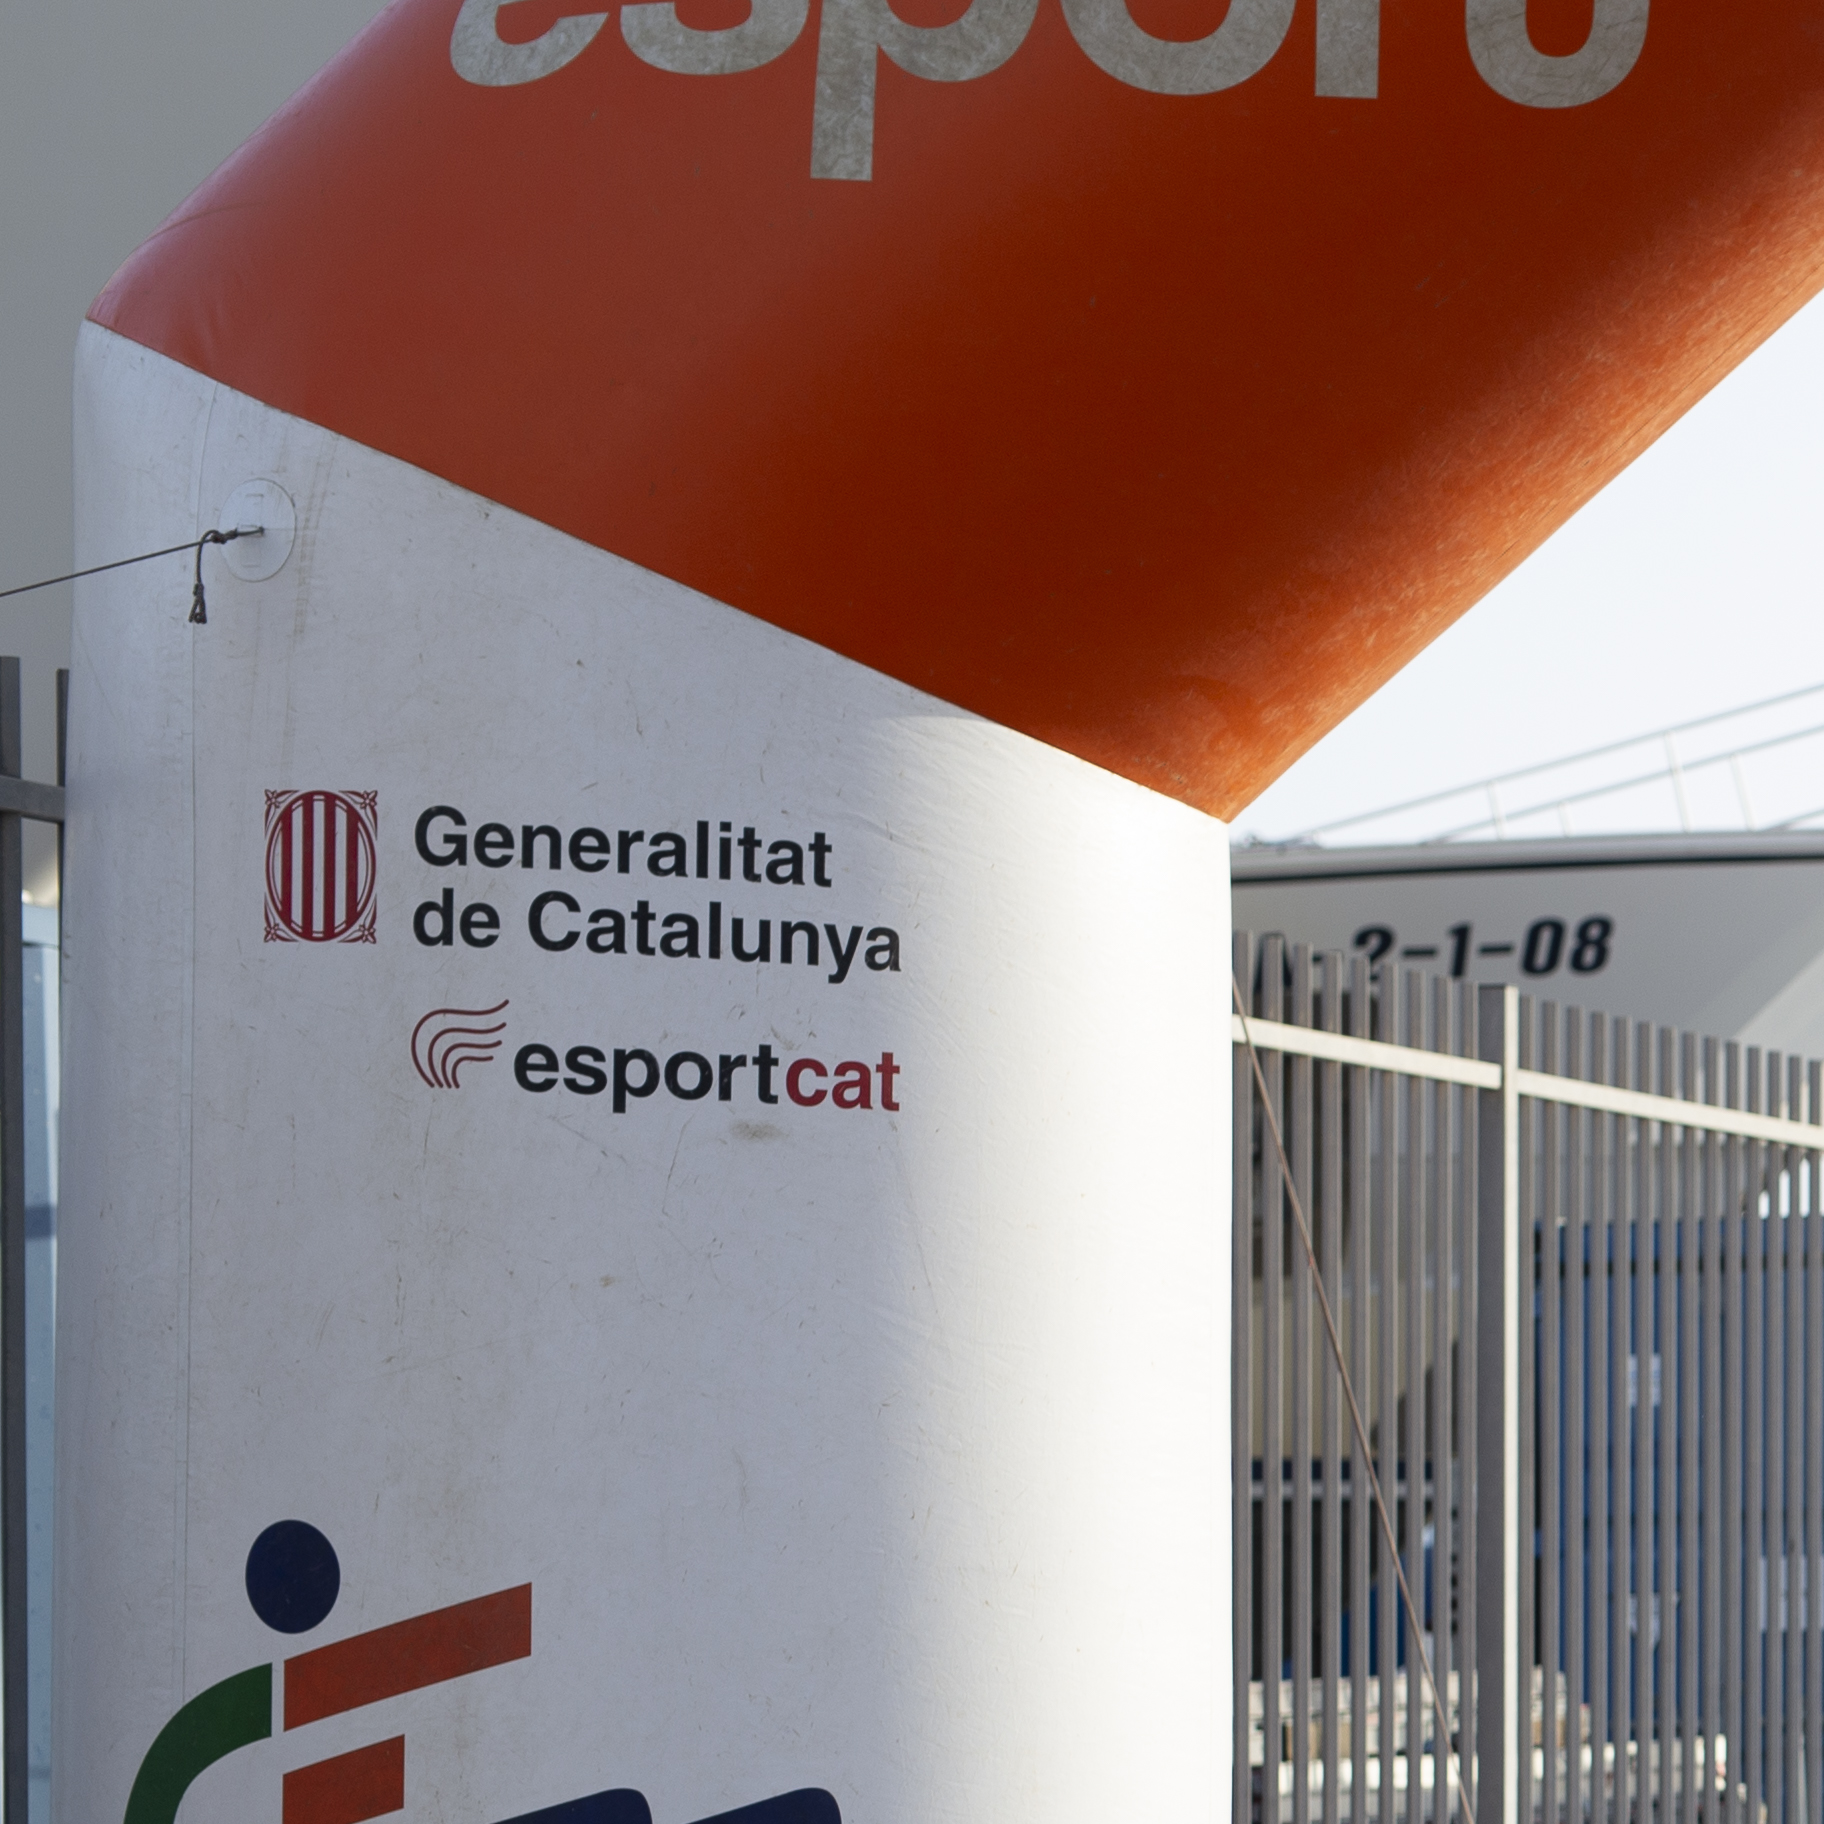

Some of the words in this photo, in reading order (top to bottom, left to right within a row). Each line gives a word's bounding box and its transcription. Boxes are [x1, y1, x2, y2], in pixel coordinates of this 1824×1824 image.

[414, 805, 833, 888] Generalitat
[412, 887, 501, 949] de
[527, 890, 902, 984] Catalunya
[513, 1043, 900, 1113] esportcat
